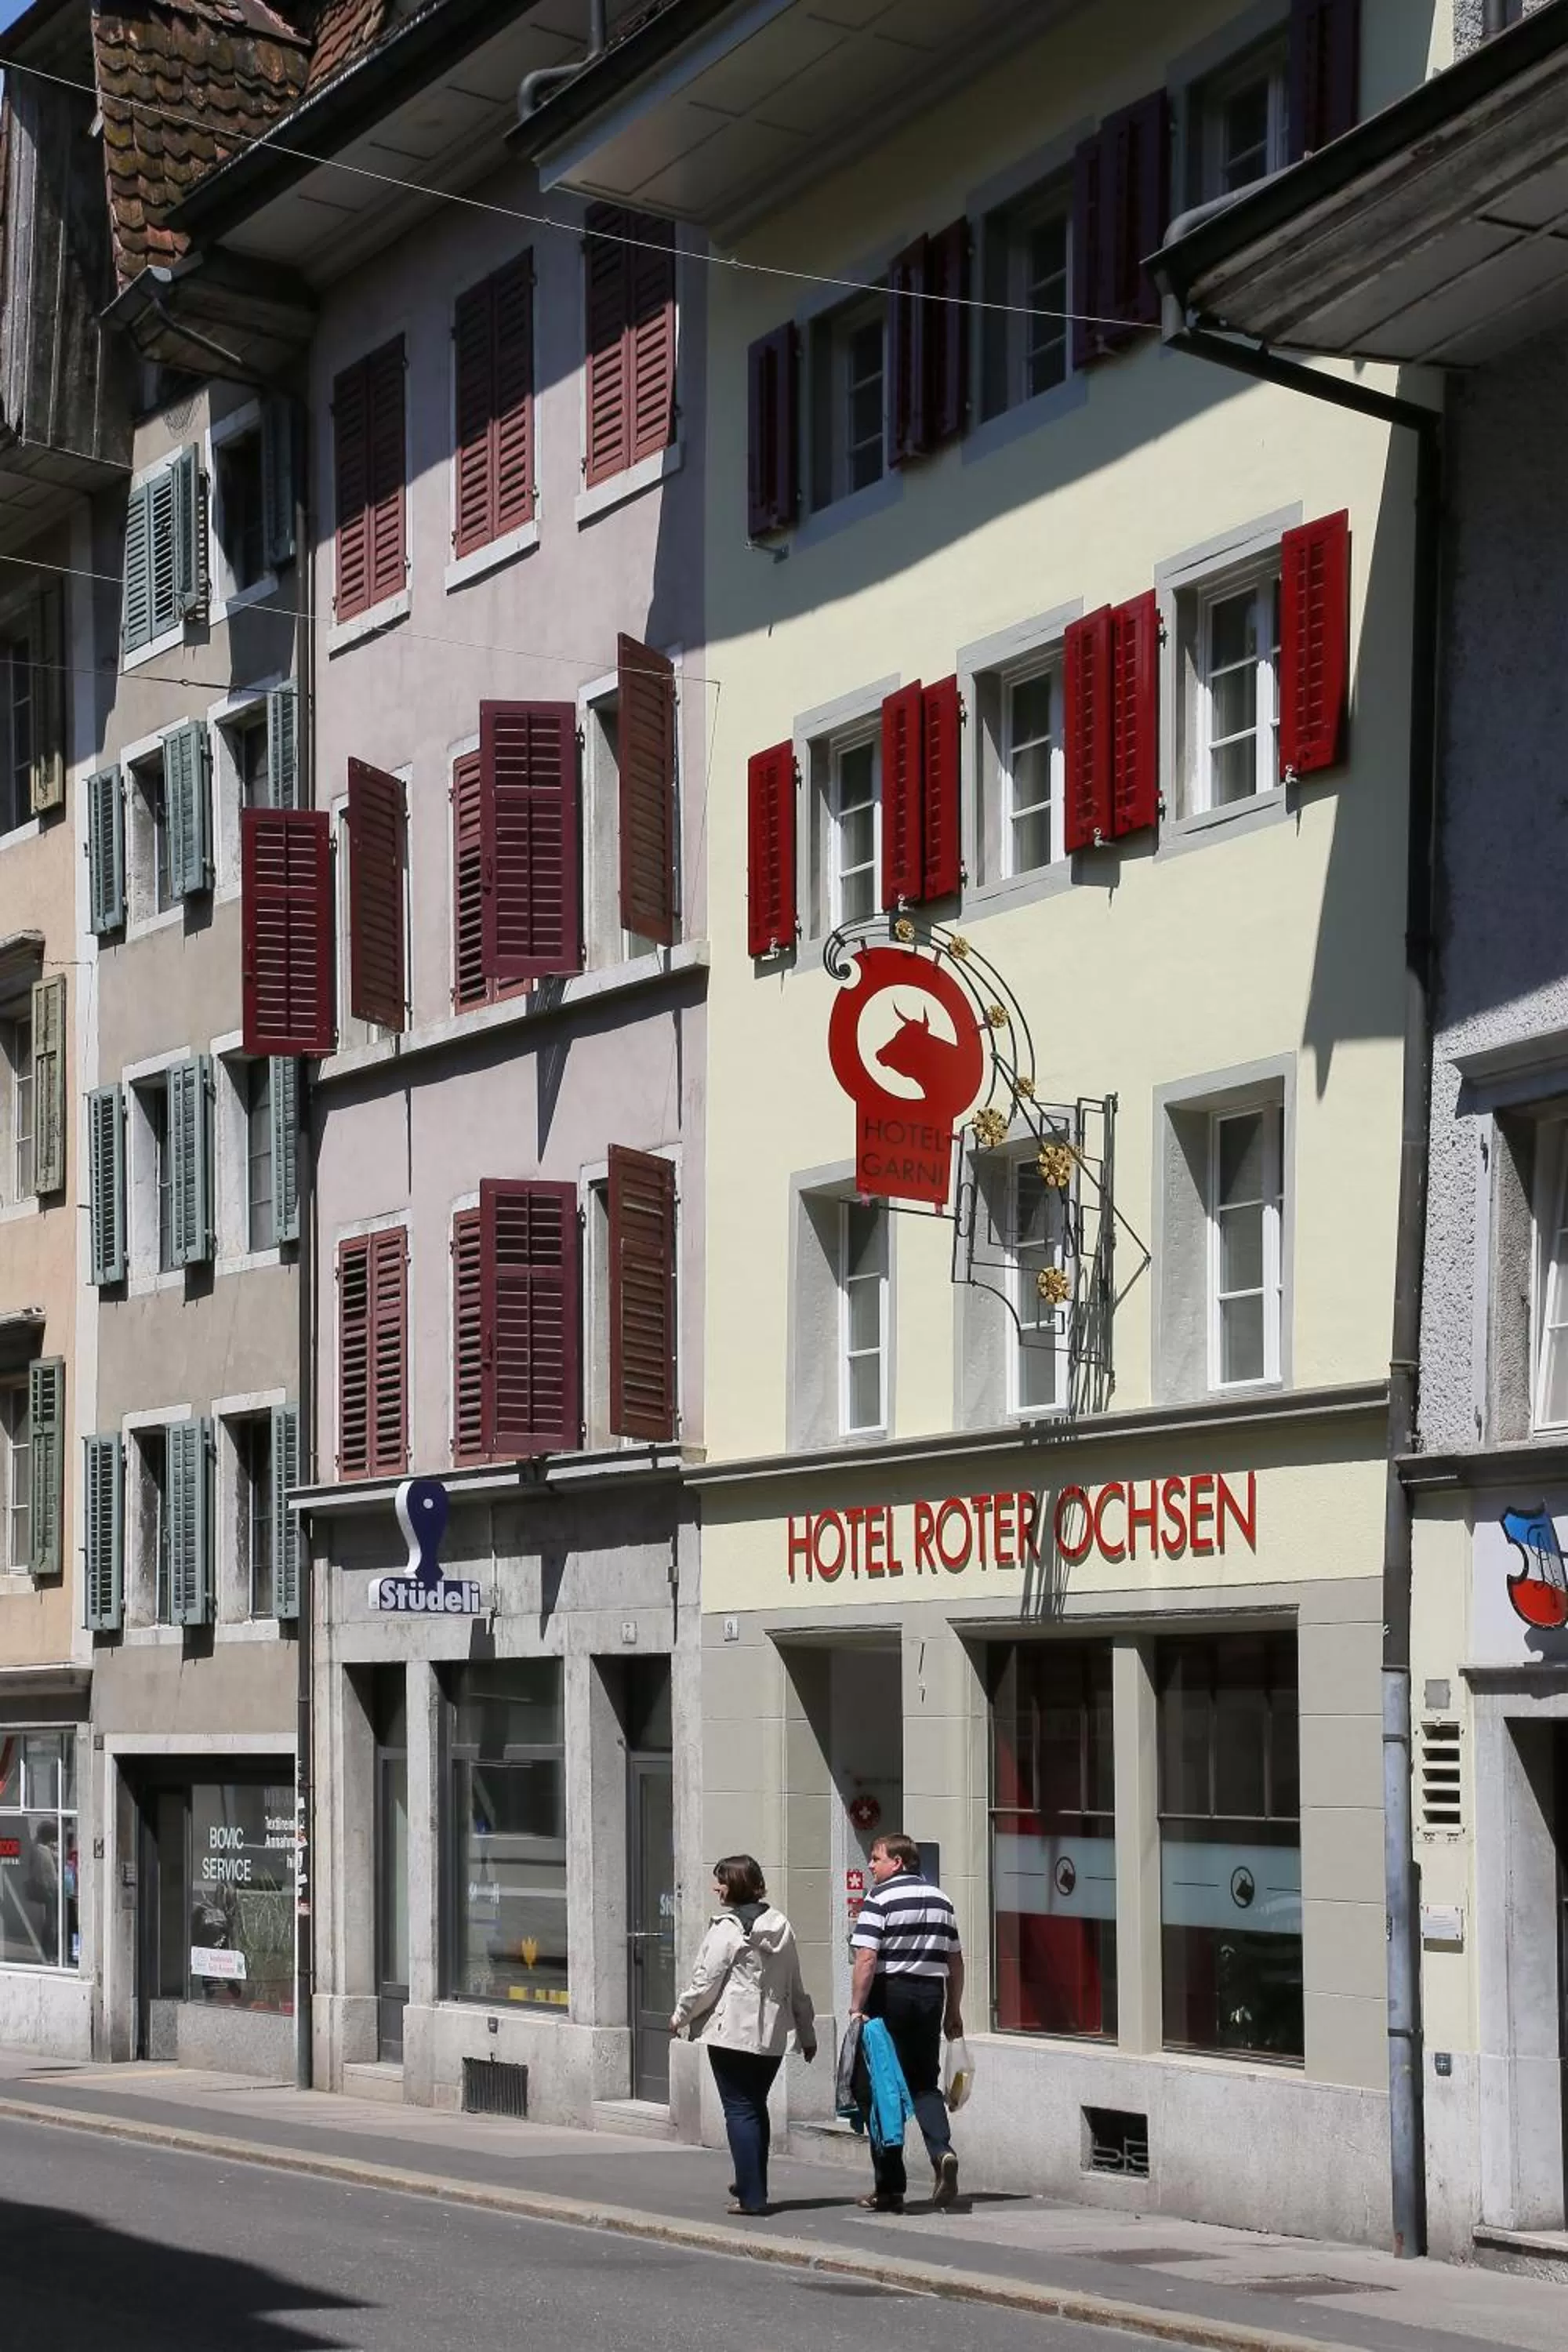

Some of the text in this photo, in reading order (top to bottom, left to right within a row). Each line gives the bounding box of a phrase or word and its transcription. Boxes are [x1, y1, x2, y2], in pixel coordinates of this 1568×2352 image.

[865, 1116, 945, 1152] HOTEL
[862, 1152, 943, 1186] GARNI
[788, 1471, 1256, 1578] HOTEL ROTER OCHSEN
[380, 1579, 479, 1613] Stüdeli
[209, 1826, 244, 1849] BOVIC
[201, 1857, 252, 1882] SERVICE
